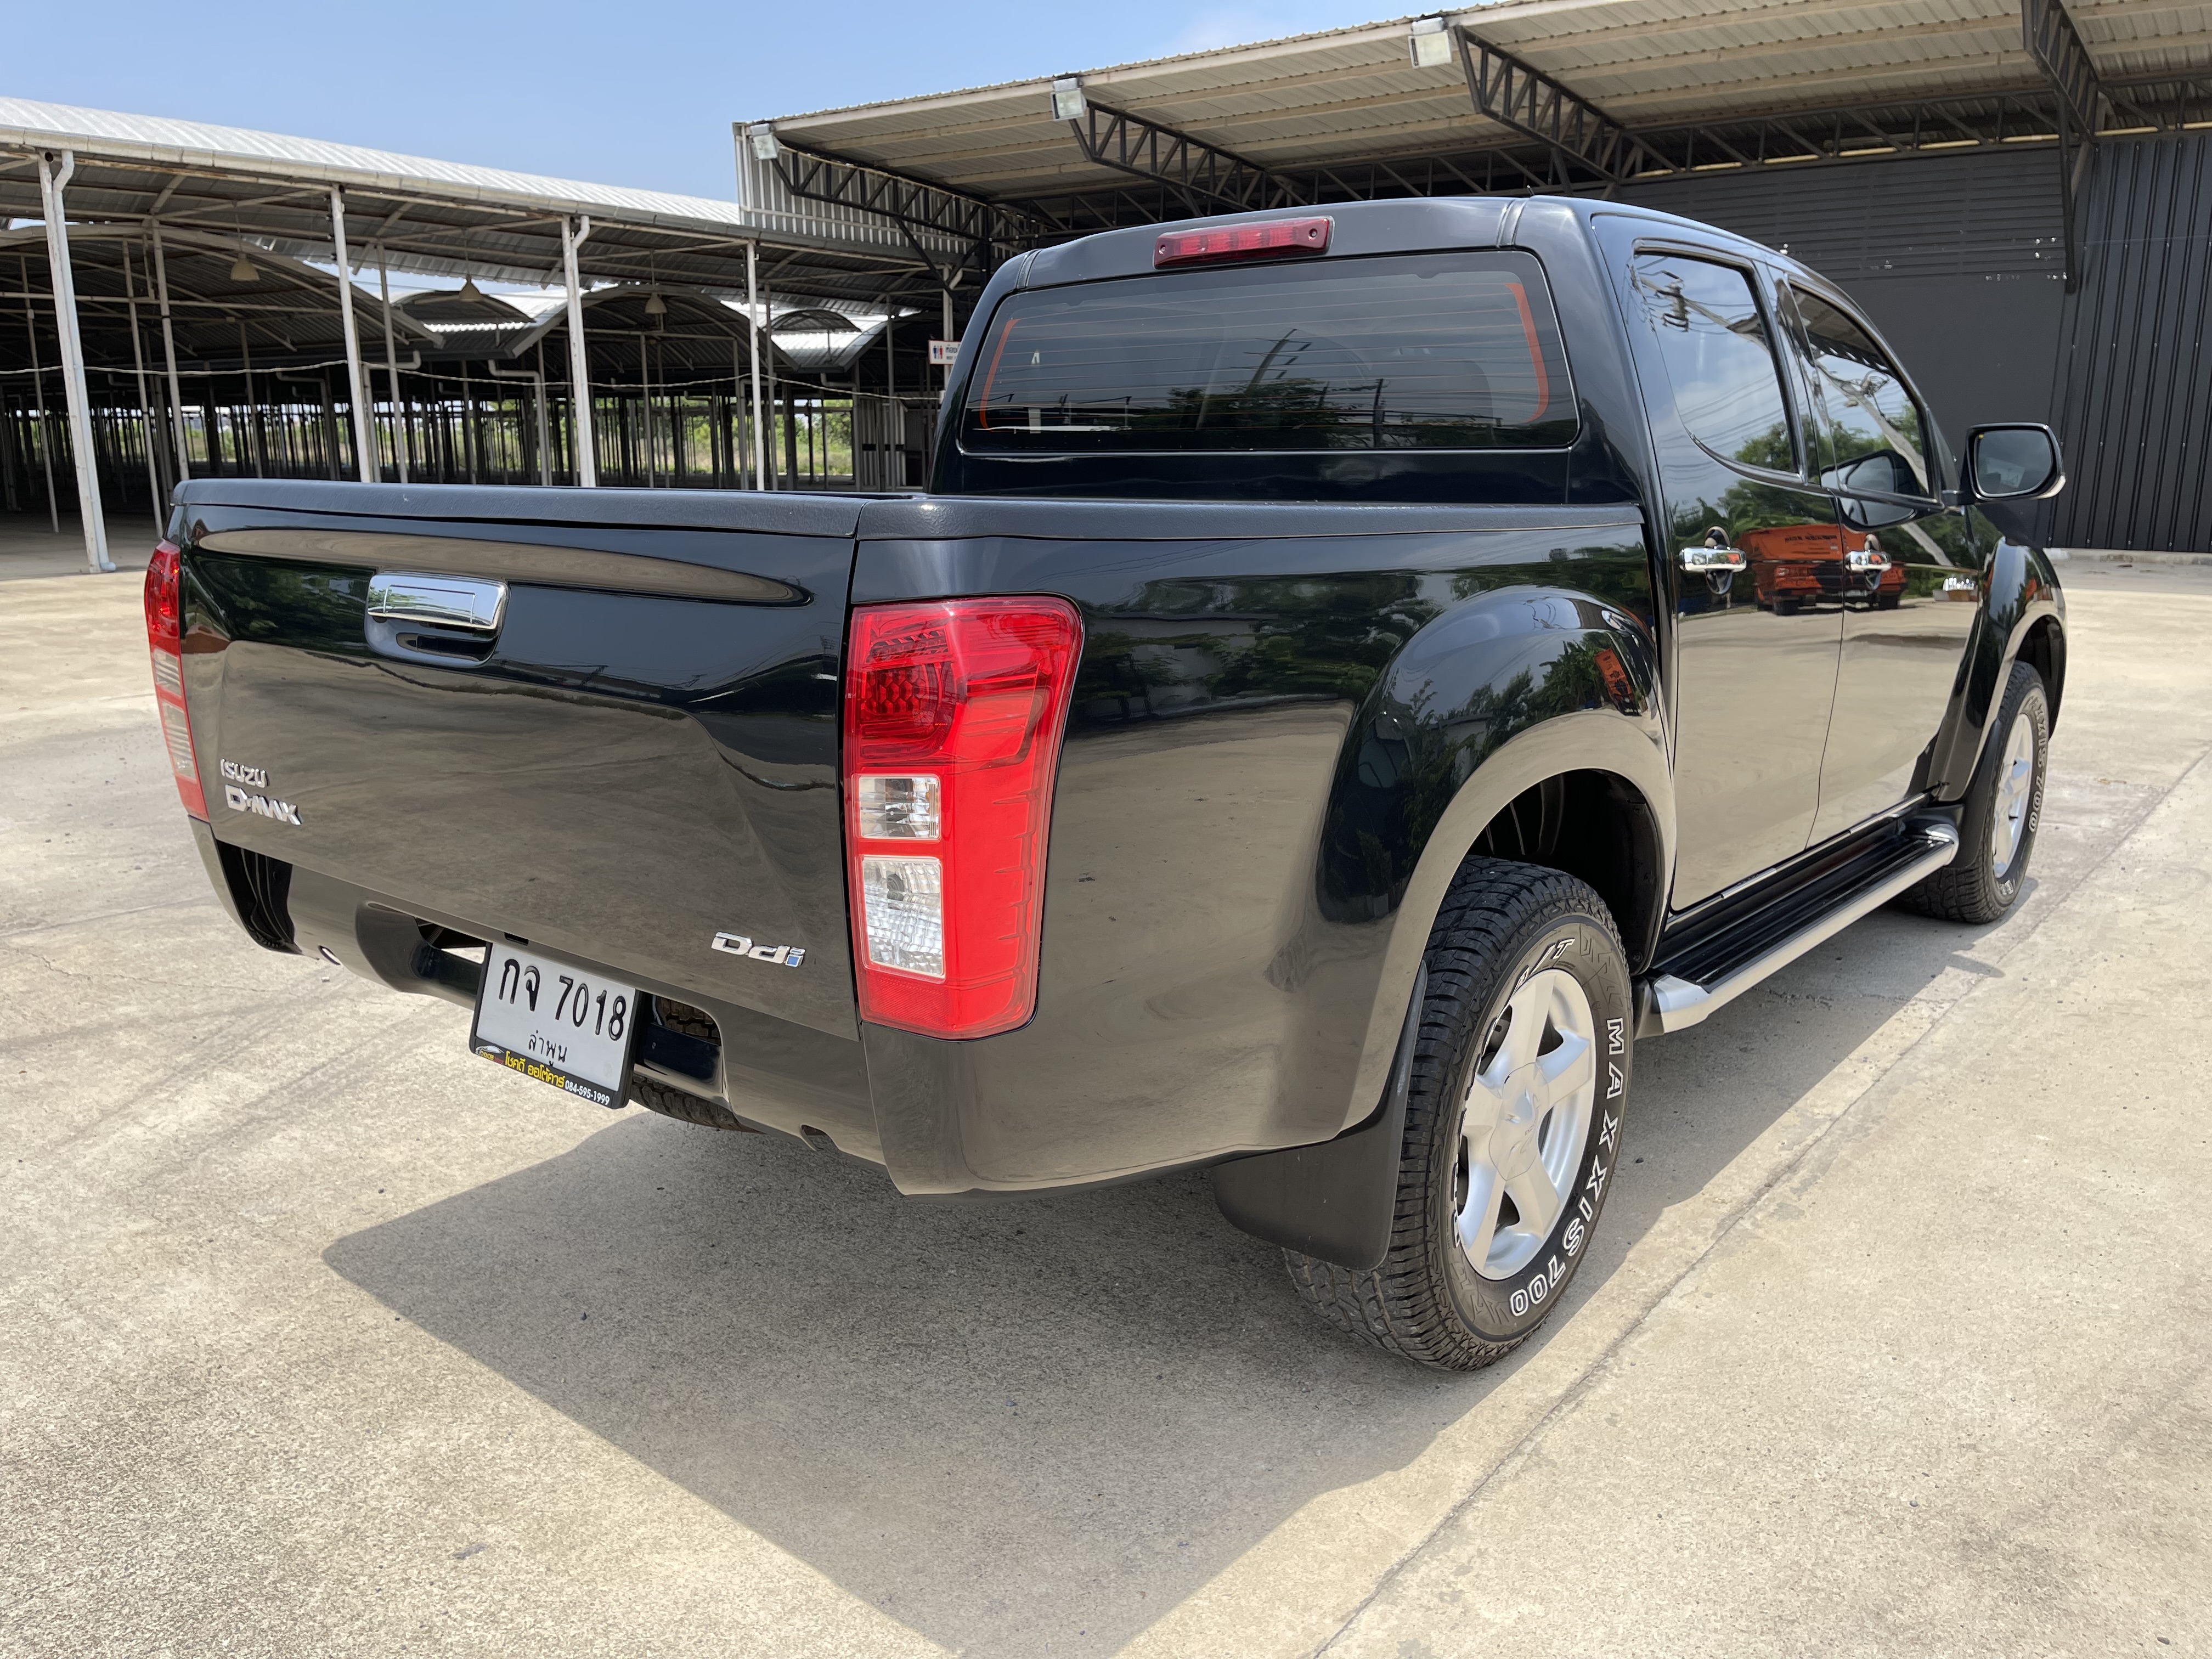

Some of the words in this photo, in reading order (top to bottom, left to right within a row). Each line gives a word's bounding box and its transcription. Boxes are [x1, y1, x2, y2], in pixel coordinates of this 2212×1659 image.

[220, 758, 266, 788] ISUZU
[225, 785, 302, 826] D-MAX
[712, 932, 805, 967] Ddi
[499, 958, 540, 1012] กจ
[555, 975, 627, 1041] 7018
[528, 1029, 567, 1067] ลำพูน
[505, 1050, 526, 1073] โชคดี
[565, 1080, 610, 1105] 084-595-1999
